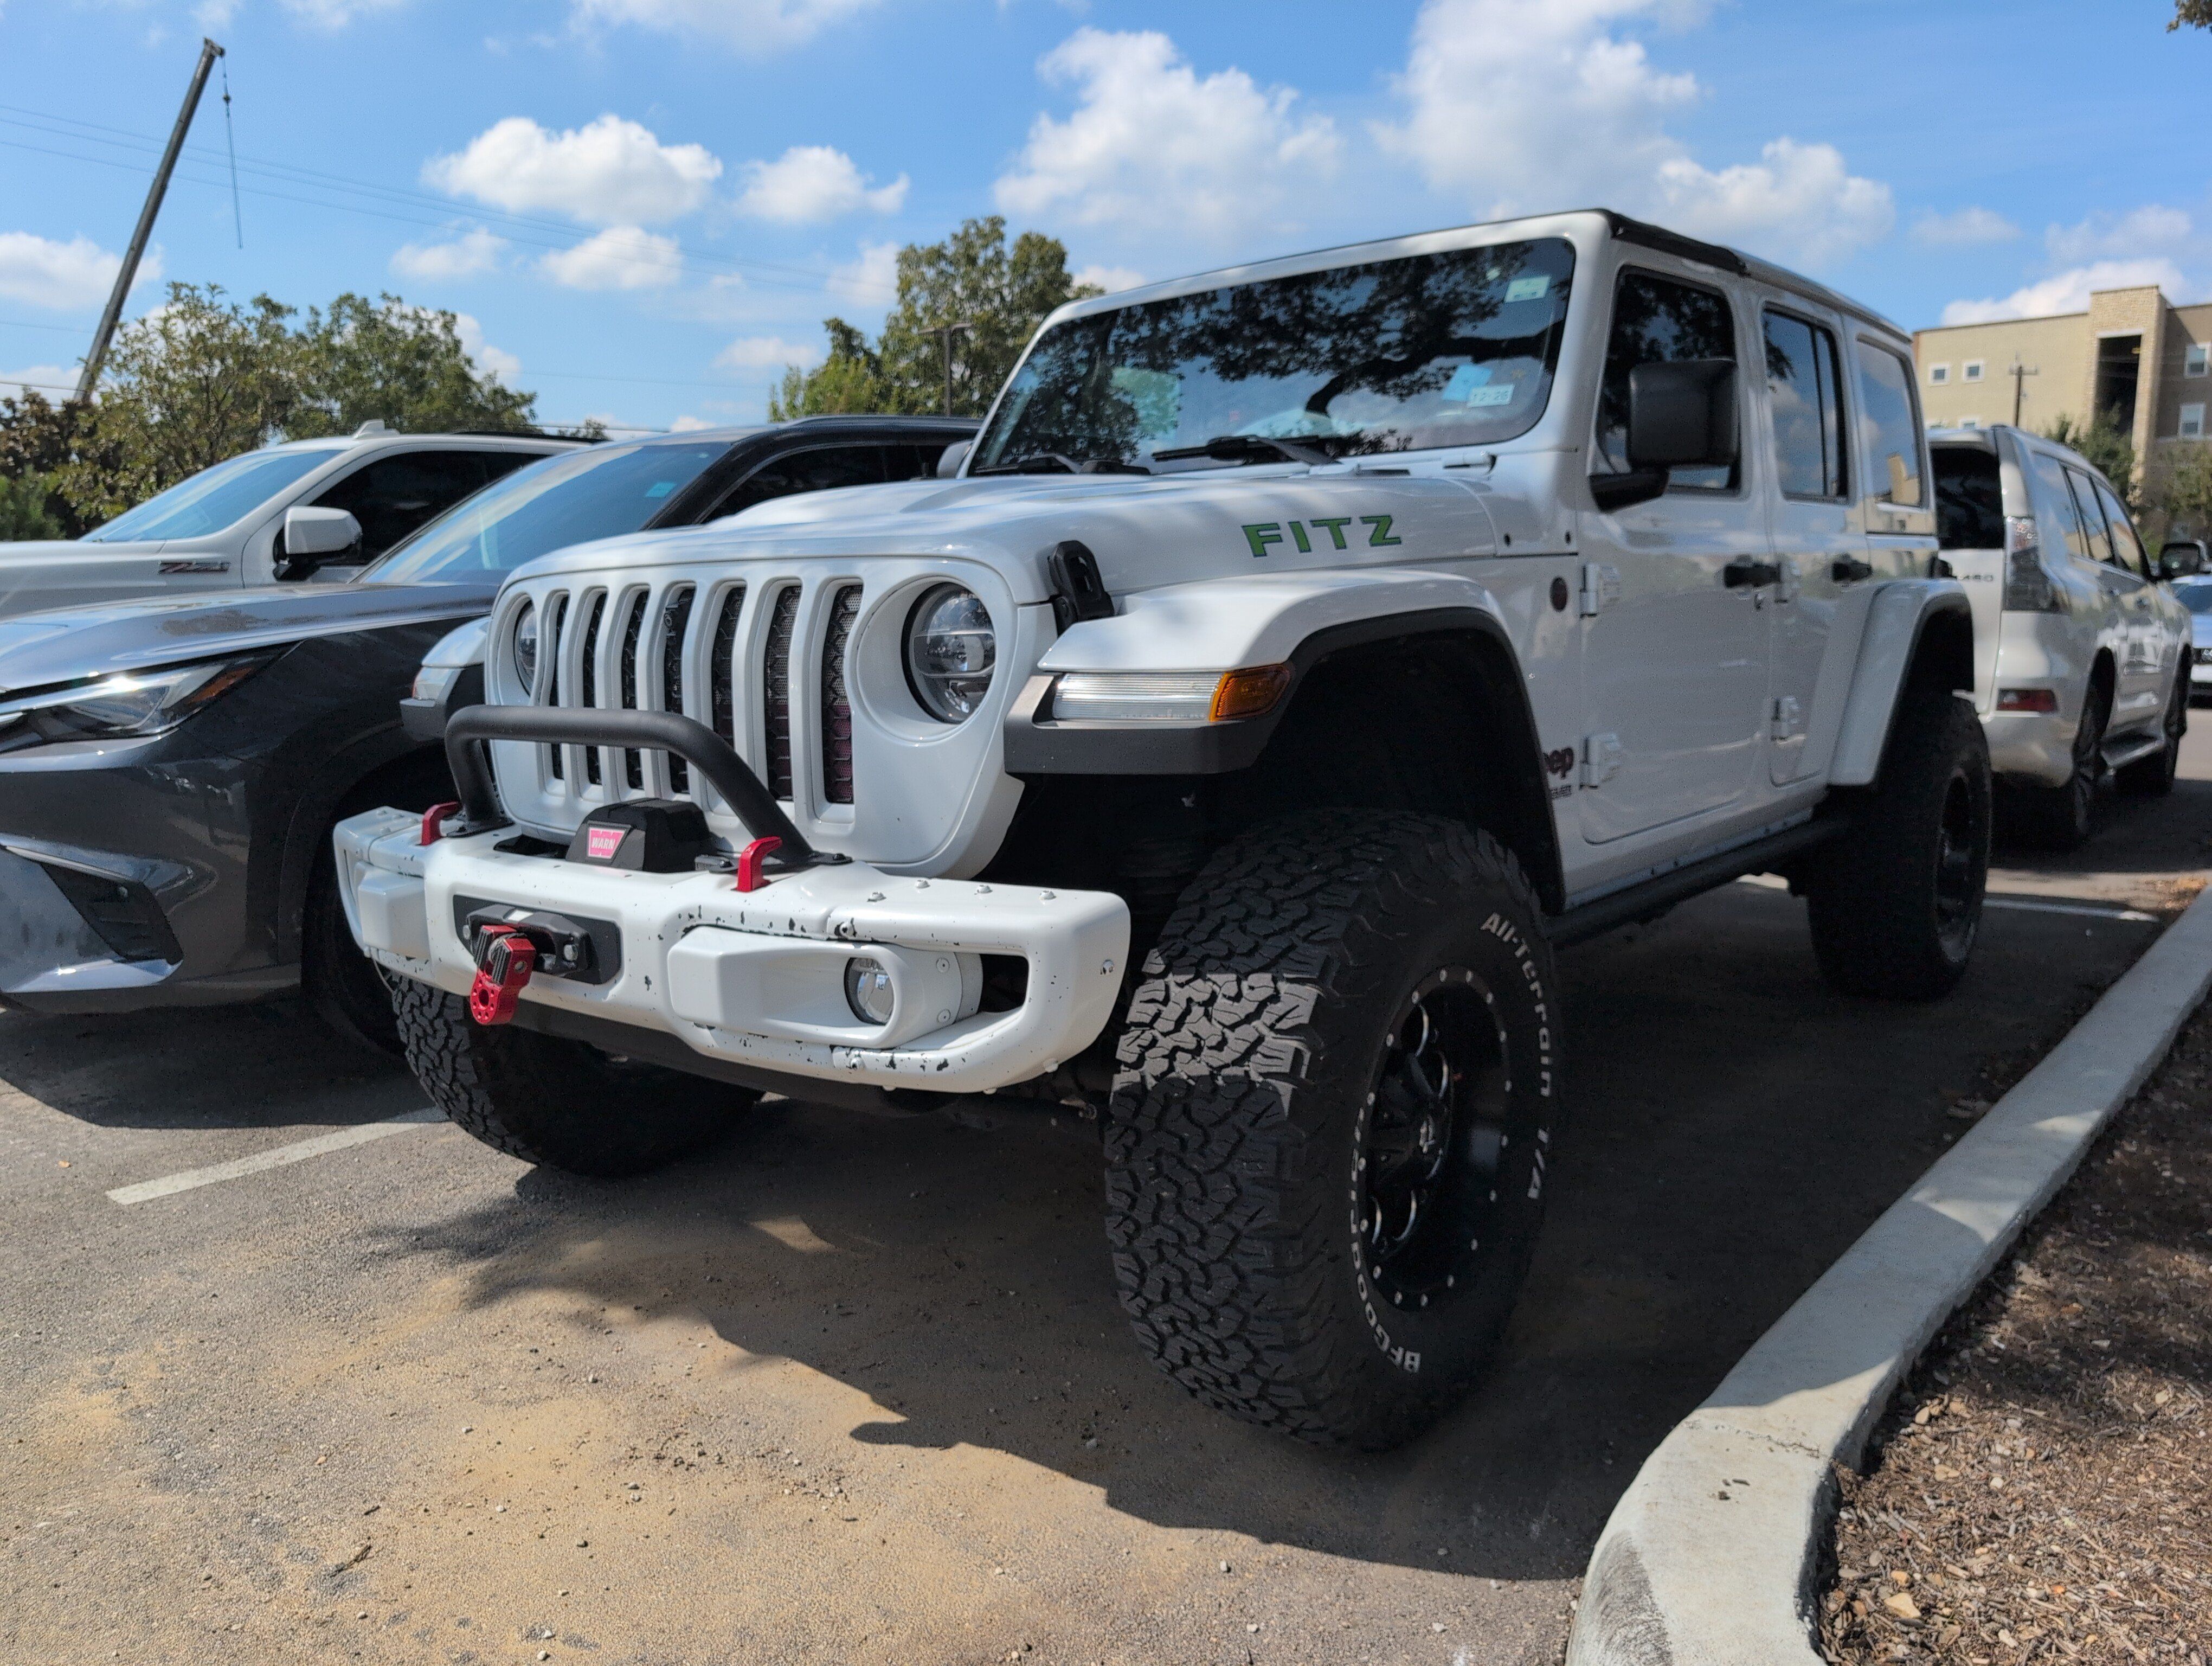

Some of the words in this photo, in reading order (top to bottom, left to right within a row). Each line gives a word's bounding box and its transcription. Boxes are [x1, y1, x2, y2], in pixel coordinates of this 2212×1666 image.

[1241, 515, 1403, 558] FITZ
[591, 837, 615, 849] WARN
[1480, 912, 1552, 1098] All-Terrain
